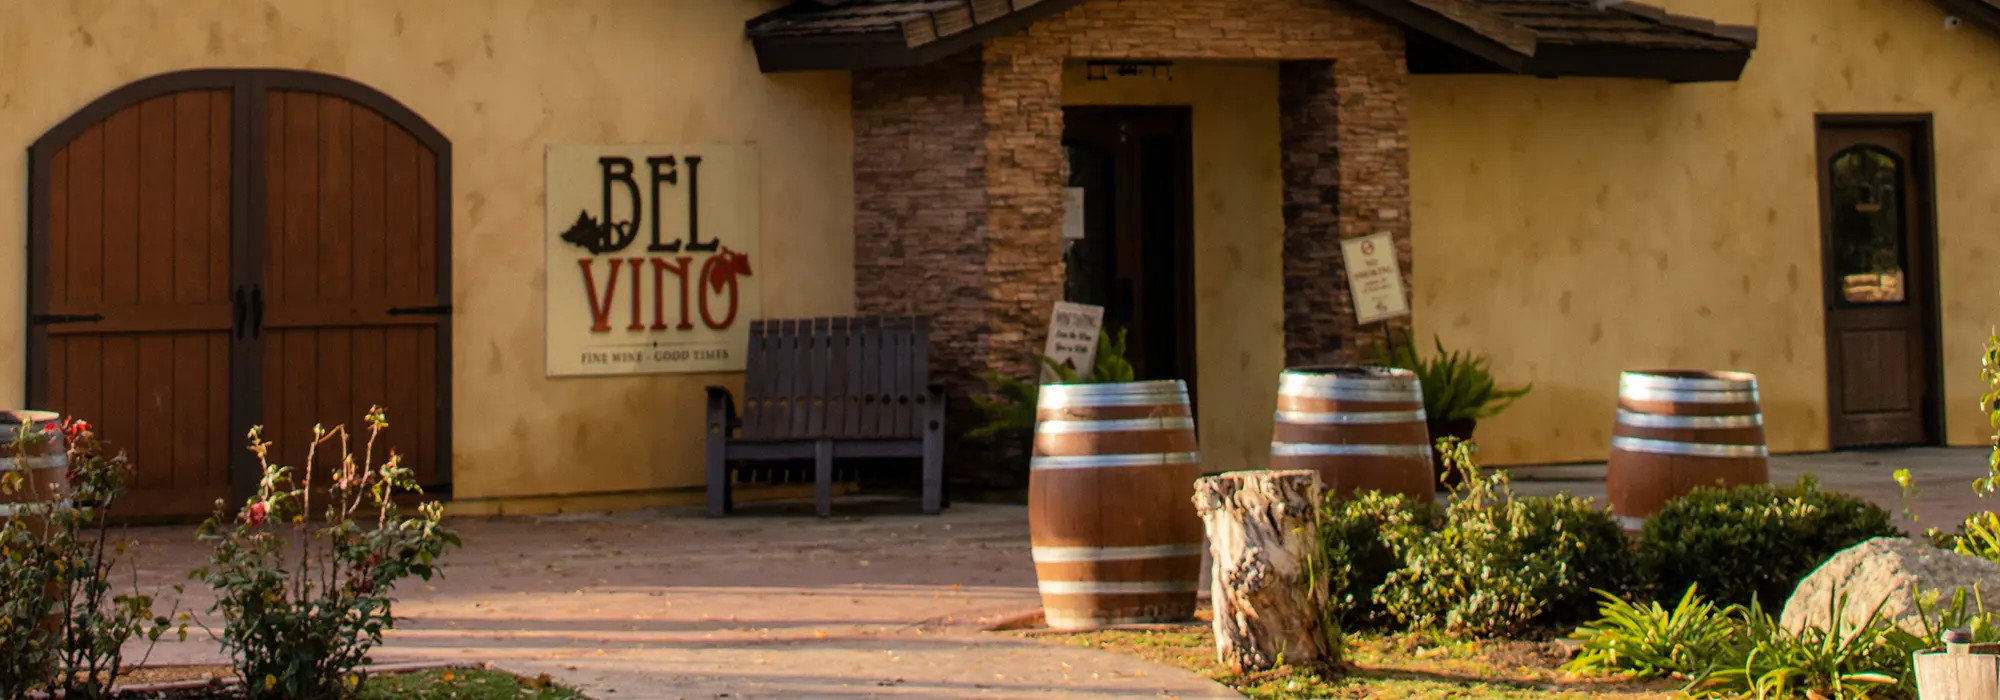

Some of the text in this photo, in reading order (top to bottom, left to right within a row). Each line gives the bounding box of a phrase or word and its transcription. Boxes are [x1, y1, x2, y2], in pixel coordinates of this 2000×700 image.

[598, 155, 720, 253] BEL
[577, 254, 739, 333] VINO
[581, 348, 730, 365] FINE WINE GOOD TIMES
